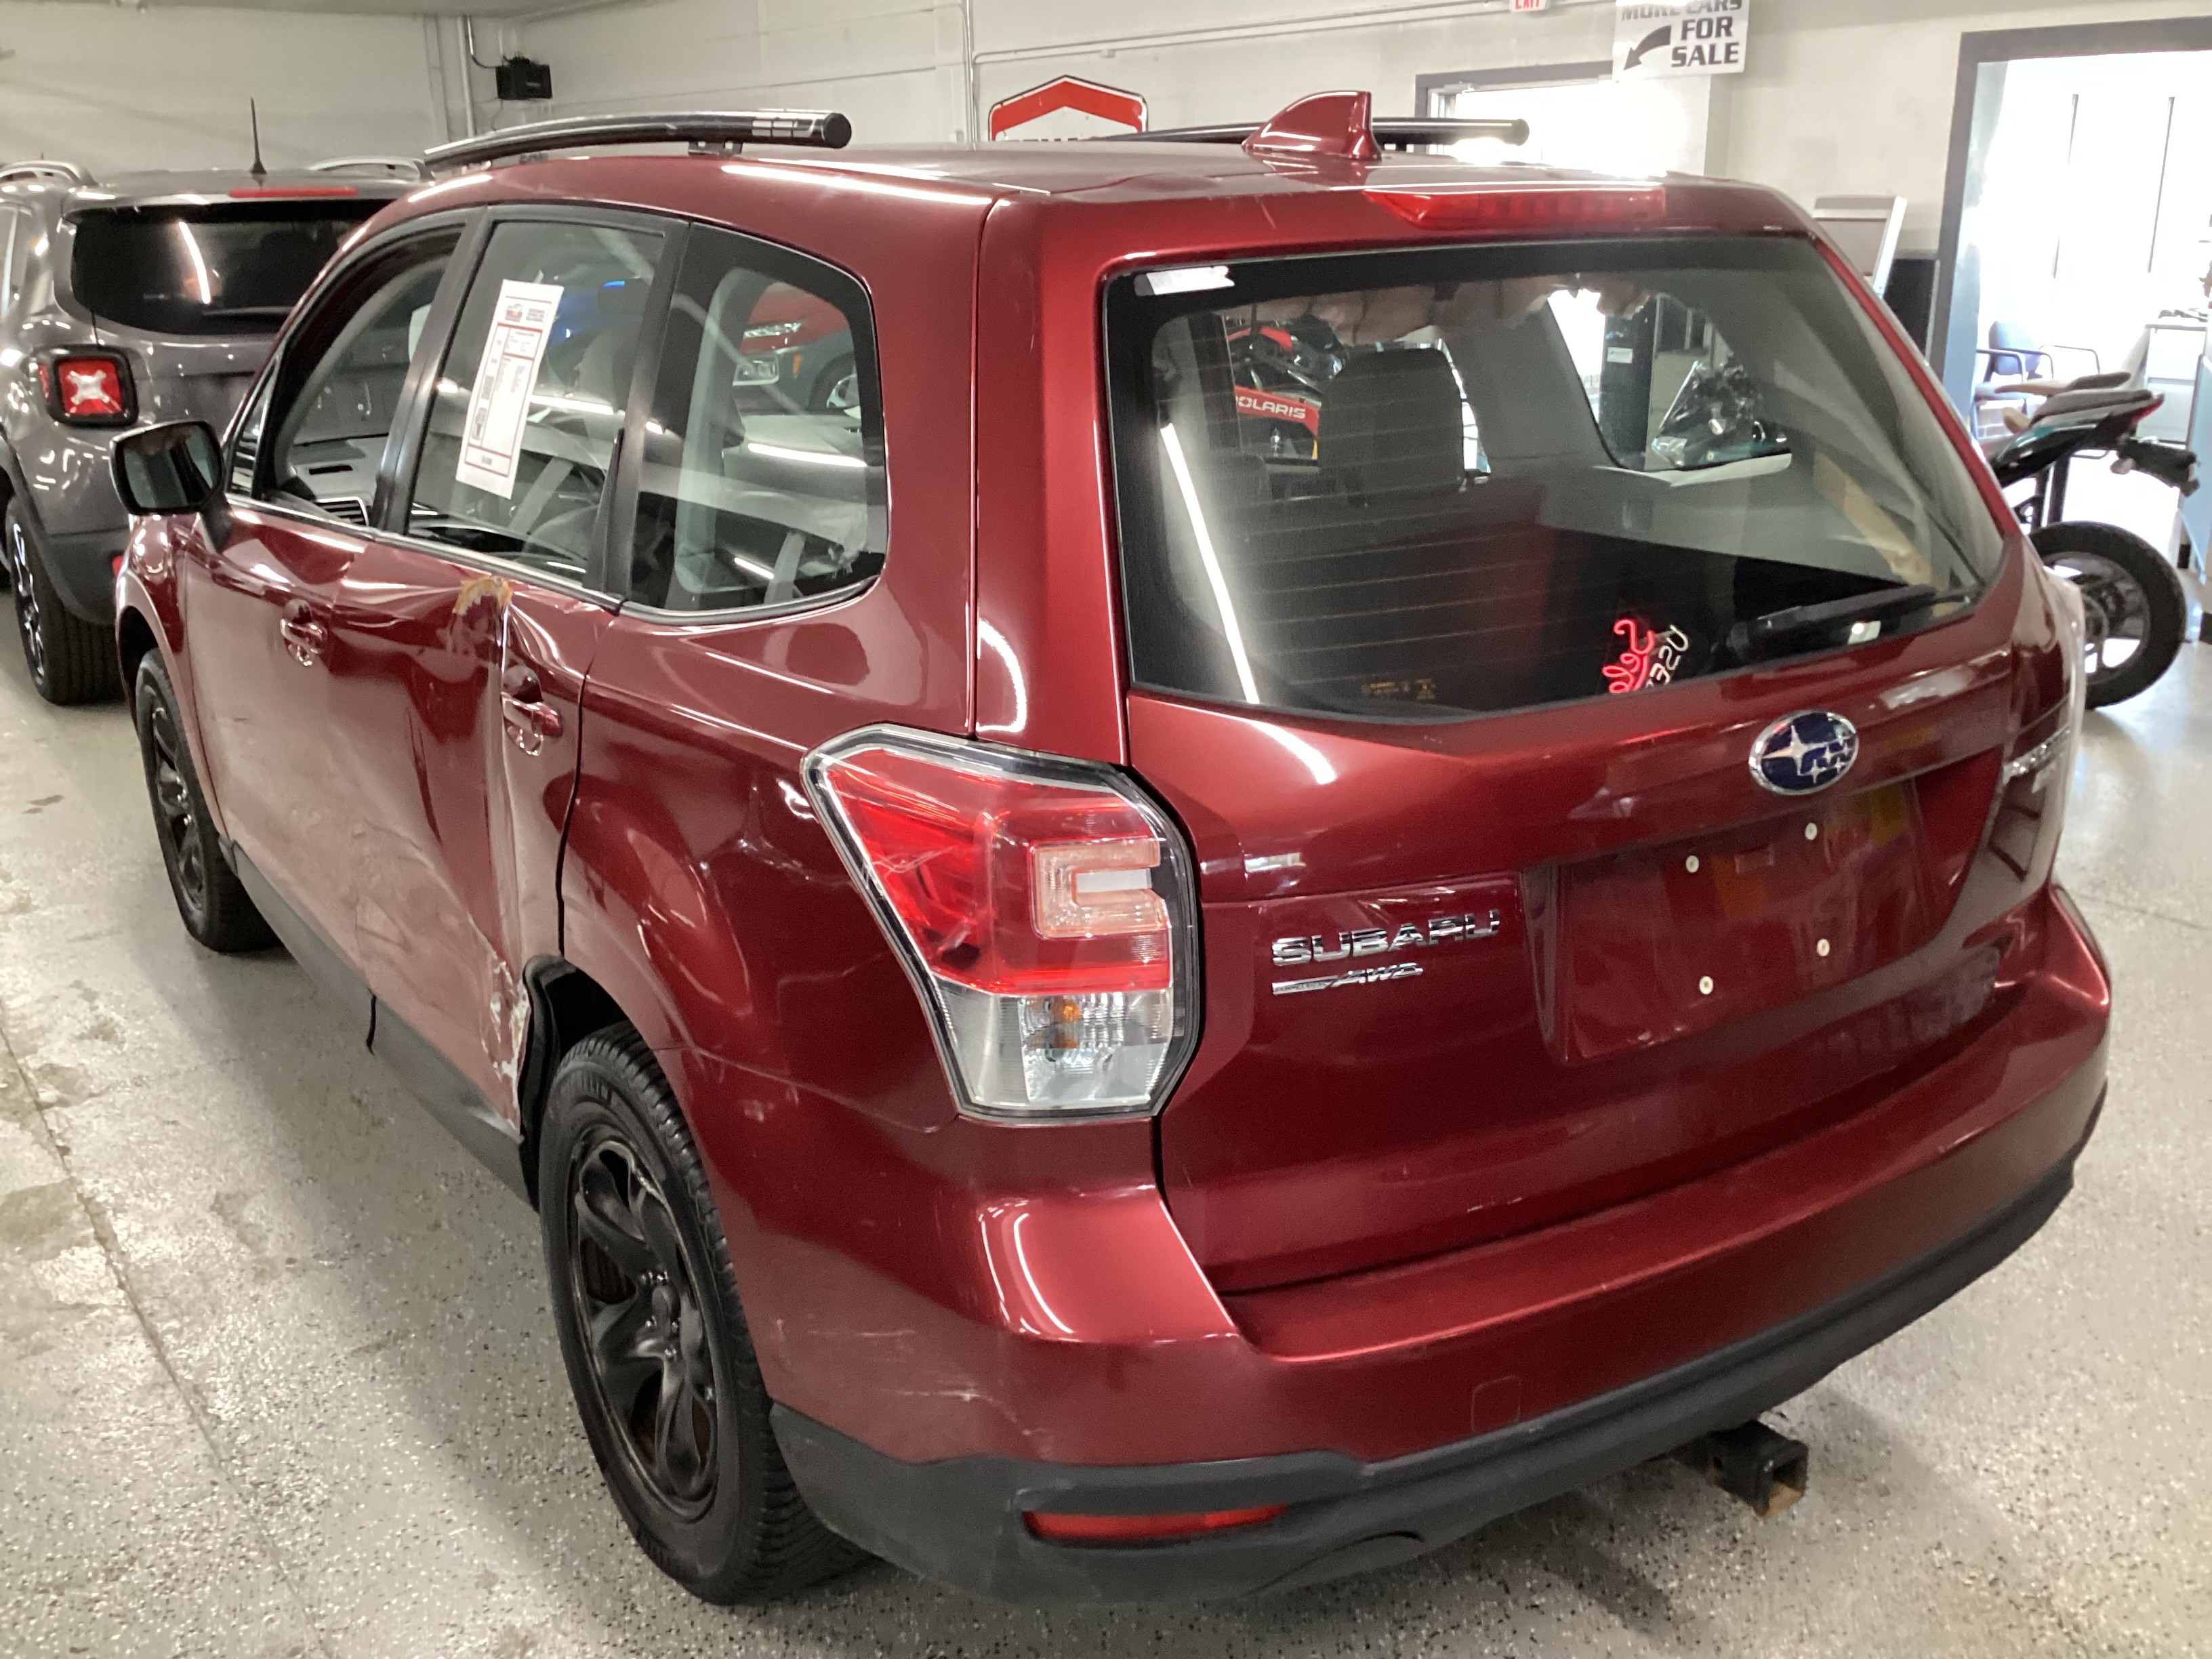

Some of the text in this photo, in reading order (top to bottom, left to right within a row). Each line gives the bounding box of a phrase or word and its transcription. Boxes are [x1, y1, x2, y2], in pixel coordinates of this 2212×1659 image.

[1681, 16, 1733, 41] FOR
[1671, 42, 1739, 67] SALE
[1235, 395, 1306, 419] OLARIS
[1271, 909, 1500, 966] SUBARU
[1329, 962, 1423, 987] AWD
